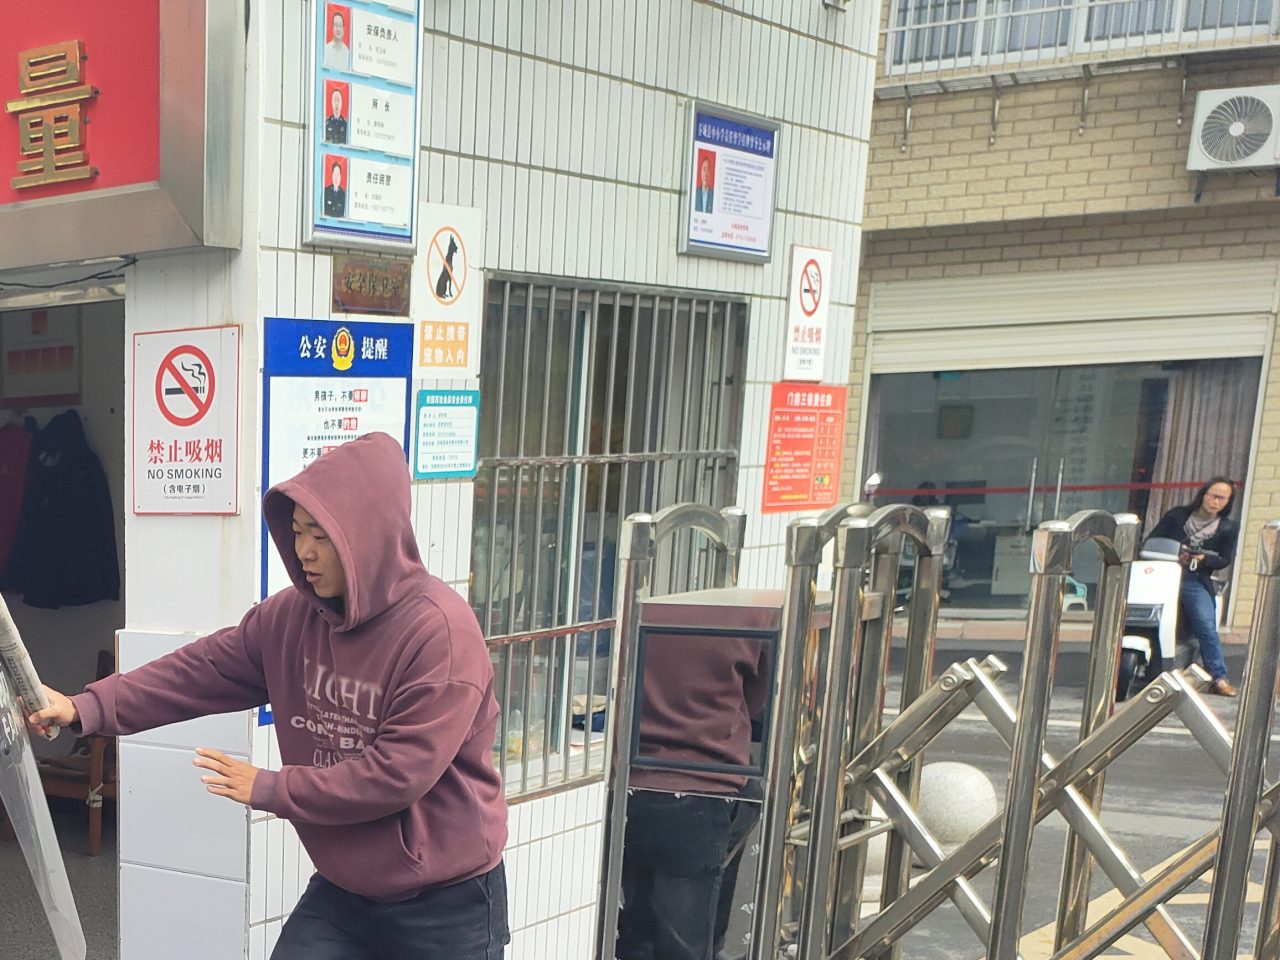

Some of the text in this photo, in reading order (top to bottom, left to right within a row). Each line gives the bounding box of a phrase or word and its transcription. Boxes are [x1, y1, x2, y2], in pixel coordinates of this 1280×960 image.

[299, 335, 388, 360] 公安 提醒
[147, 438, 223, 464] 禁止吸烟
[147, 467, 222, 480] NO SMOKING
